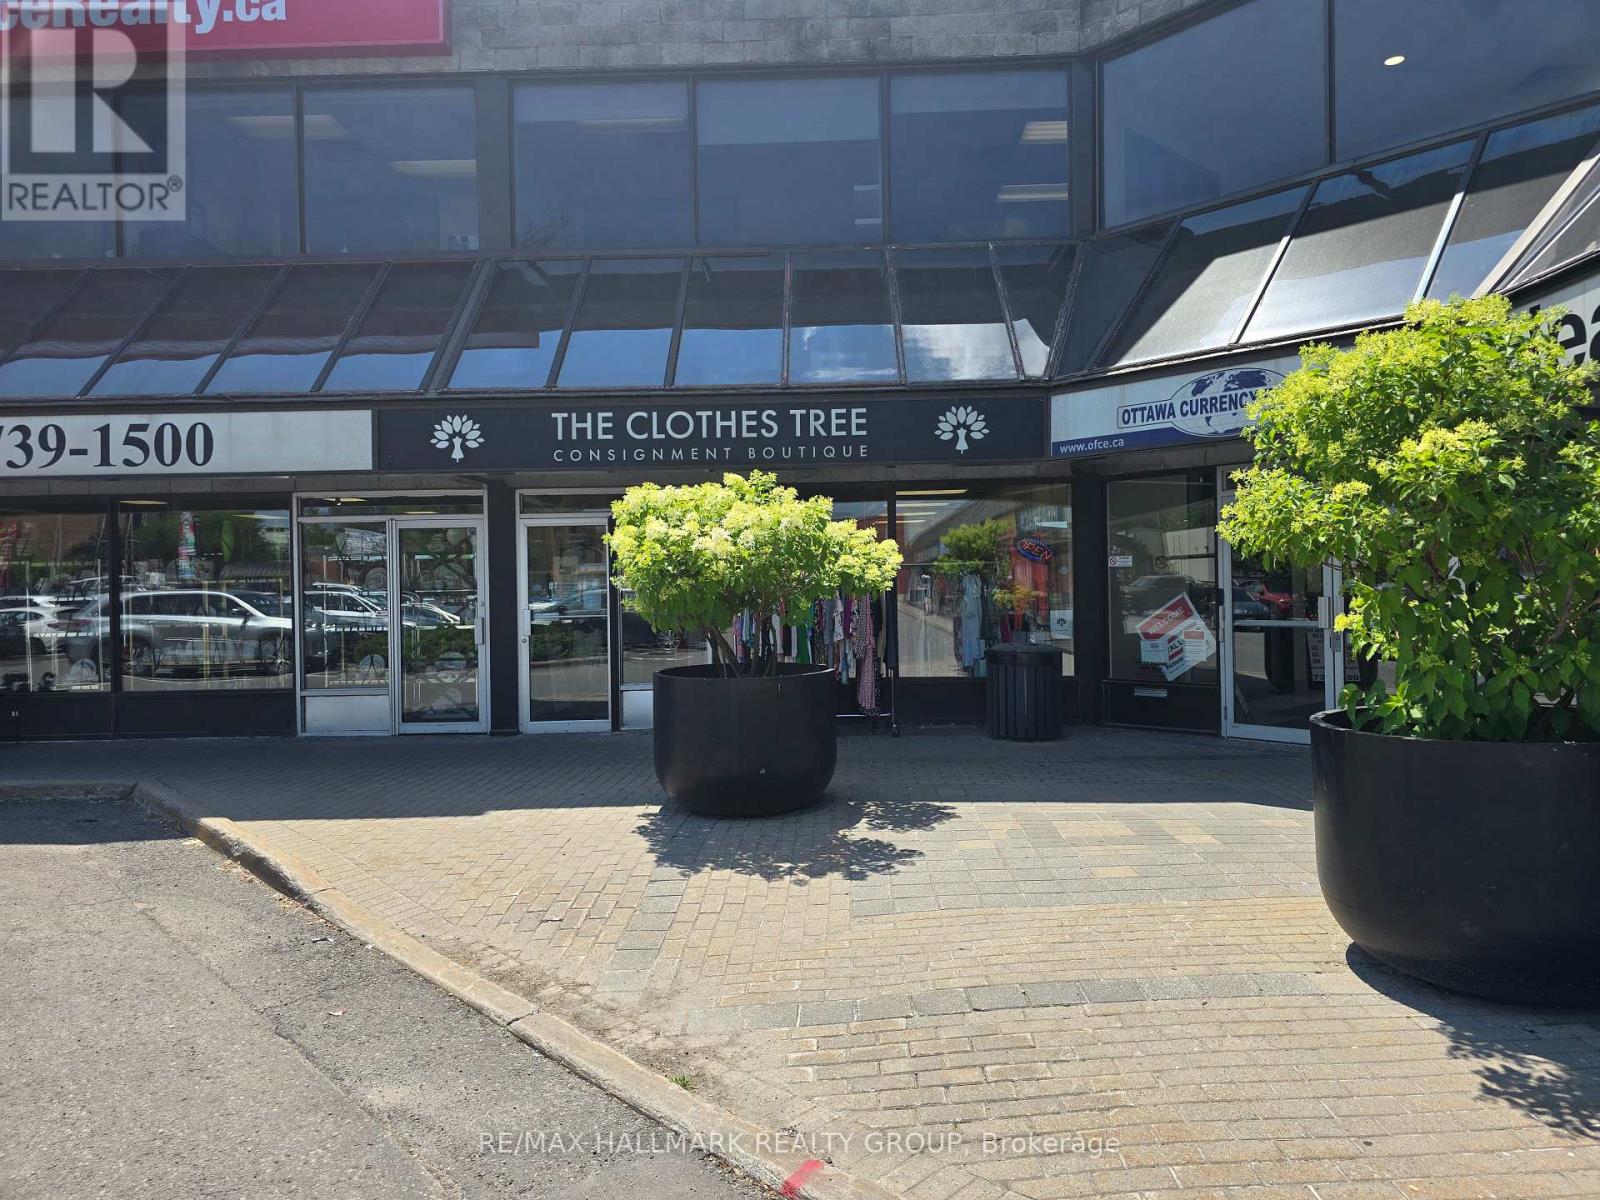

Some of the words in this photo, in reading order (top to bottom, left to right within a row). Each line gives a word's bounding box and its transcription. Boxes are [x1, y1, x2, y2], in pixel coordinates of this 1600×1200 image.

[551, 412, 614, 440] THE
[626, 410, 779, 439] CLOTHES
[789, 407, 868, 437] TREE
[1121, 403, 1177, 426] OTTAWA
[0, 422, 214, 469] 39-1500
[553, 447, 732, 462] CONSIGNMENT
[748, 445, 869, 461] BOUTIQUE
[1059, 437, 1125, 455] www.ofce.ca
[1016, 538, 1053, 561] OPEN
